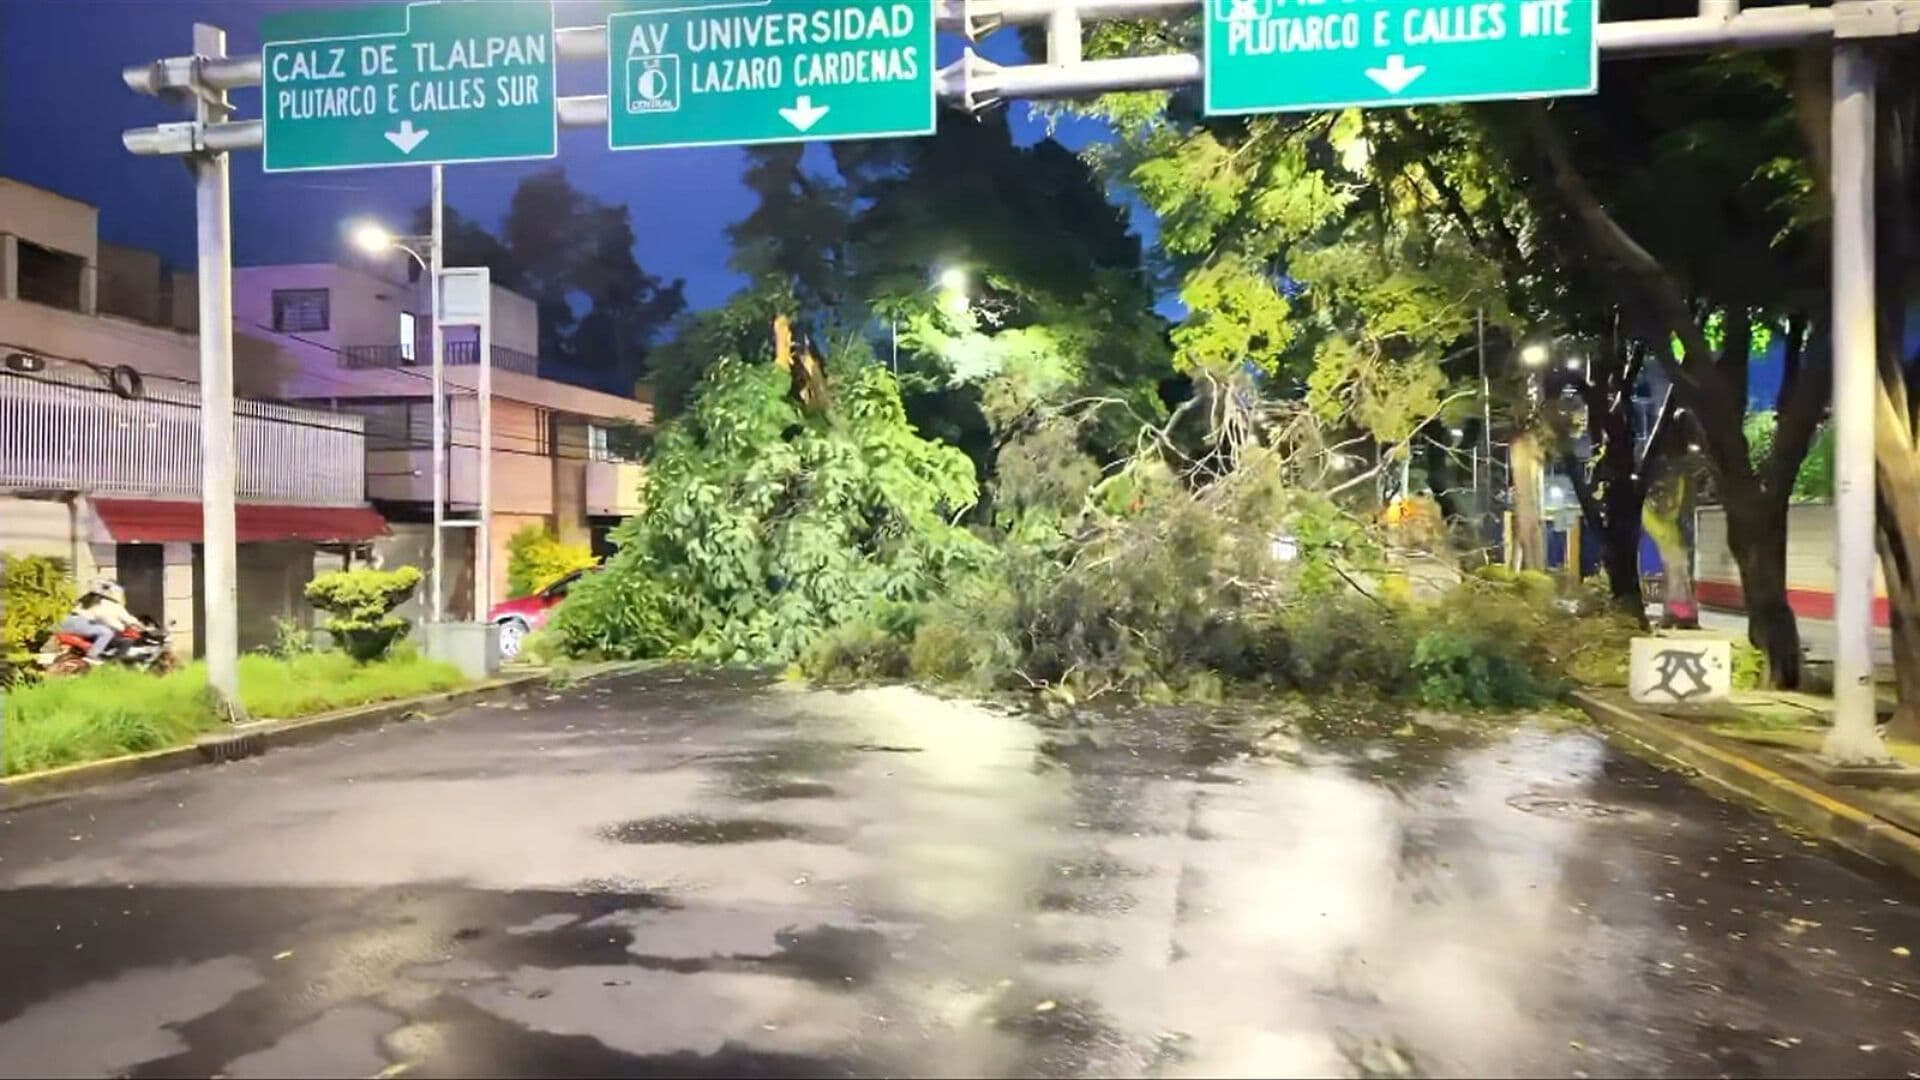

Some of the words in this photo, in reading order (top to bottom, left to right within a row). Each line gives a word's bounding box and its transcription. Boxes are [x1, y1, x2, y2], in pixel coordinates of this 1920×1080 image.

[627, 23, 669, 55] AV
[687, 4, 914, 52] UNIVERSIDAD
[1228, 12, 1359, 57] PLUTARCO
[1373, 10, 1391, 47] E
[1403, 5, 1506, 45] CALLES
[1519, 1, 1571, 37] NTE
[272, 48, 346, 82] CALZ
[361, 44, 398, 76] DE
[412, 34, 545, 73] TLALPAN
[691, 55, 782, 93] LAZARO
[794, 47, 918, 87] CARDENAS
[279, 84, 376, 120] PLUTARCO
[388, 83, 399, 114] E
[410, 78, 485, 112] CALLES
[497, 75, 538, 107] SUR
